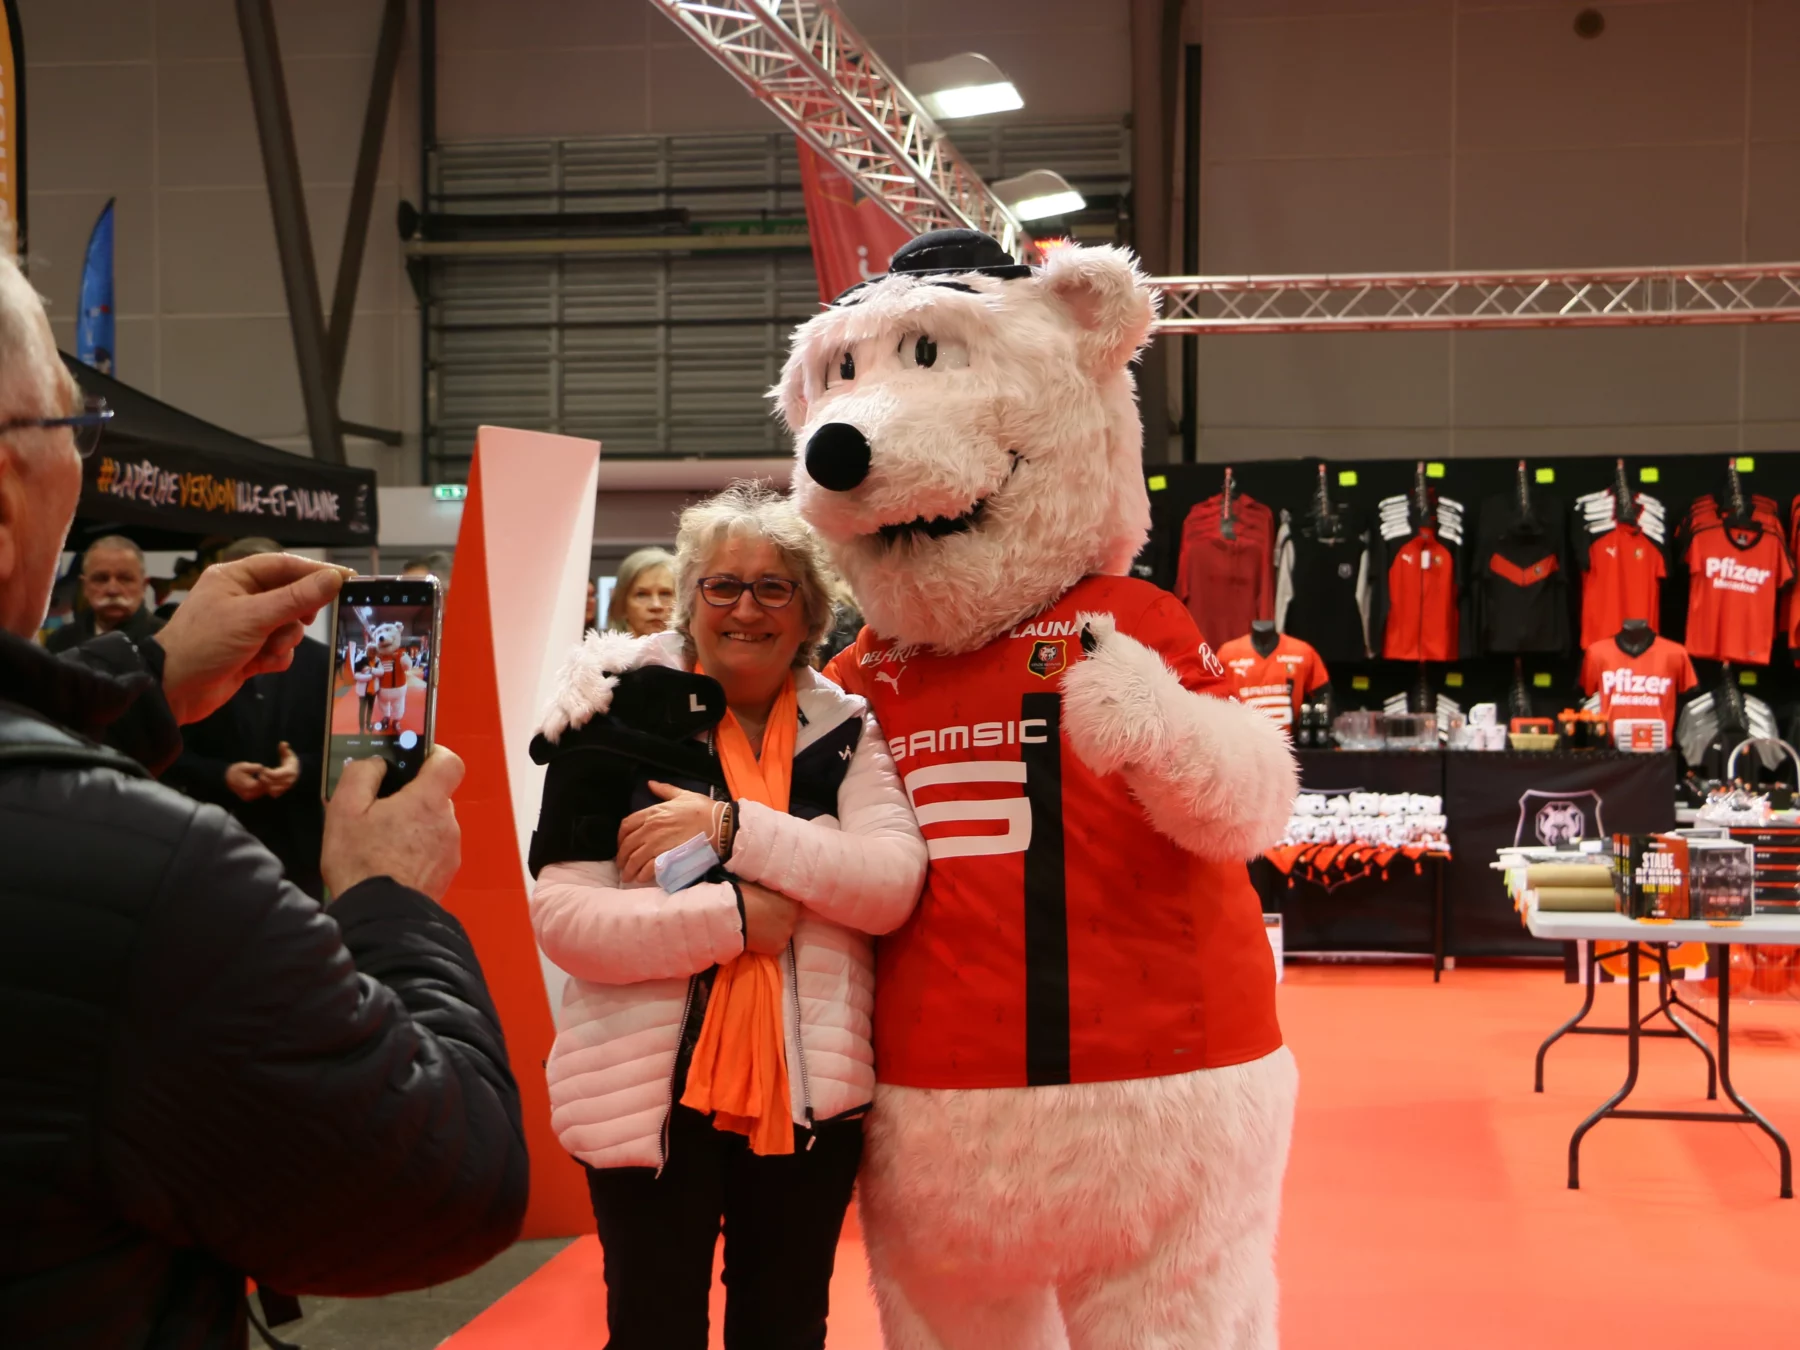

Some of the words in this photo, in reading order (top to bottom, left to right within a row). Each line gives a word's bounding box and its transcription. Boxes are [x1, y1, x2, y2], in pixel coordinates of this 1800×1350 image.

[1706, 556, 1771, 585] Pfizer
[1009, 621, 1078, 639] LAUNA
[1602, 667, 1671, 695] Pfizer
[689, 693, 707, 713] L
[888, 719, 1048, 762] SAMSIC
[1642, 852, 1674, 869] STADE
